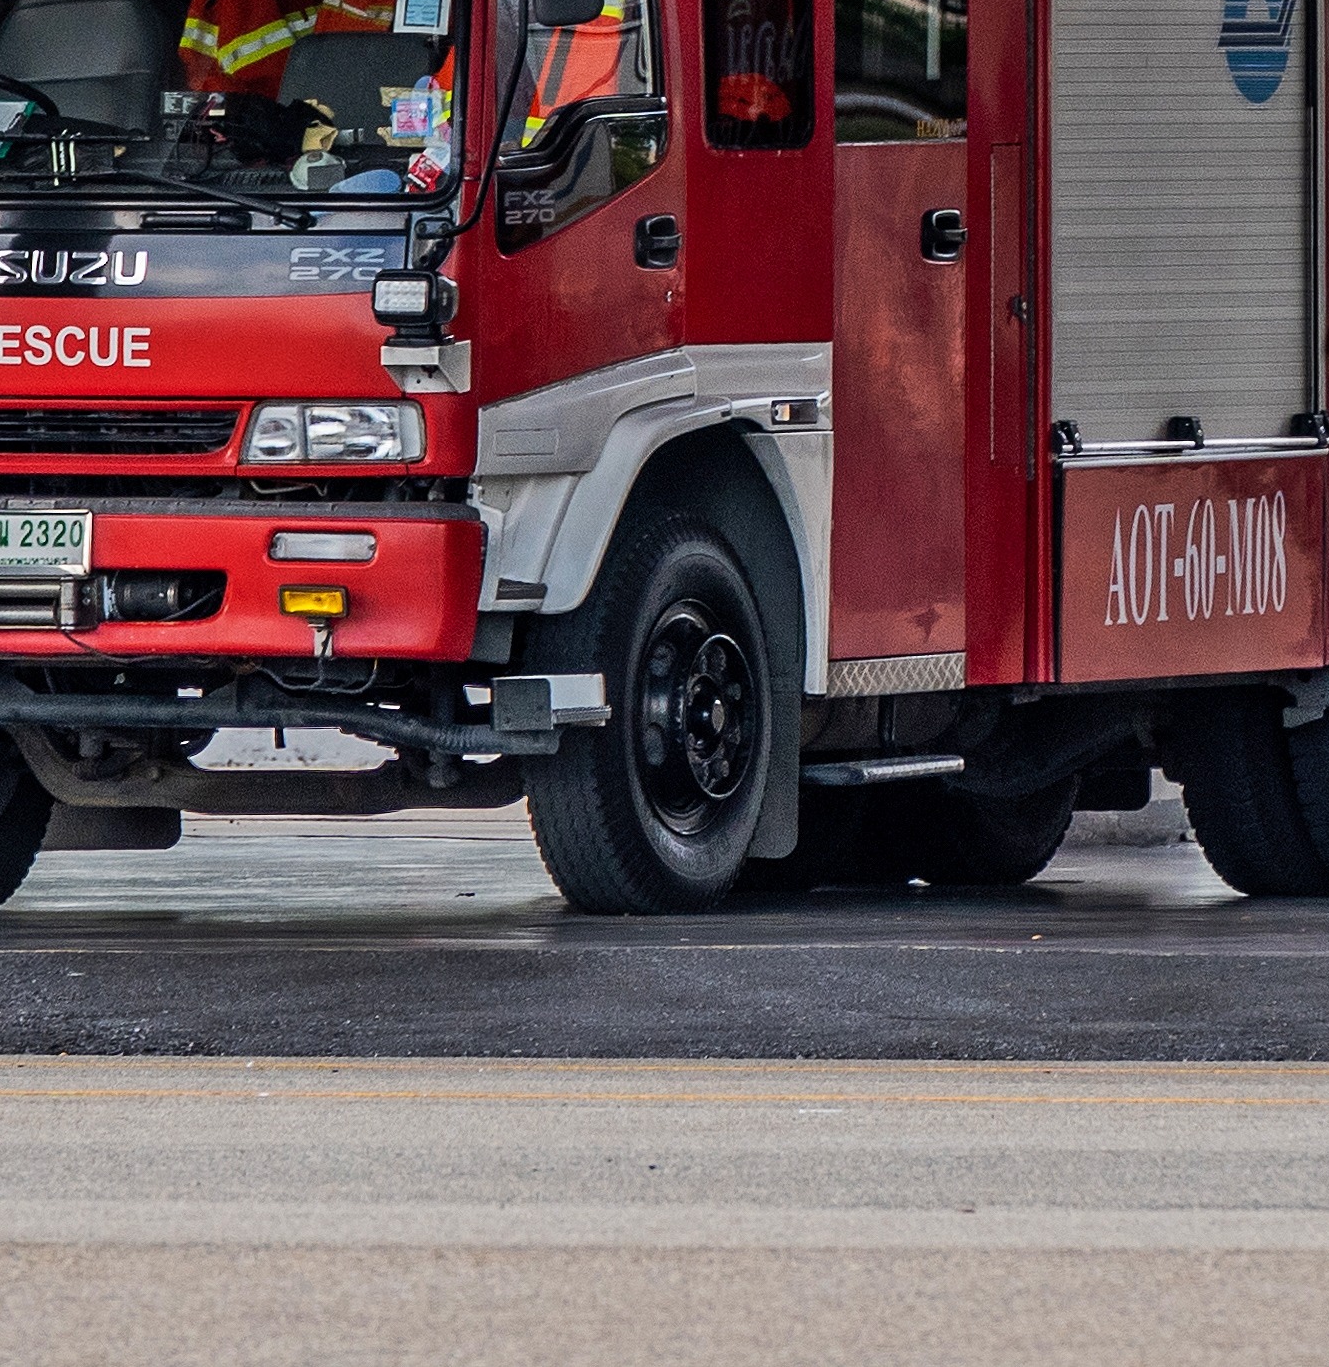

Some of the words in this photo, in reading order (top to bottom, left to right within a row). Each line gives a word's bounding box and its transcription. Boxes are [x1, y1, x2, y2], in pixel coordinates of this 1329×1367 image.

[504, 190, 555, 206] FXZ
[505, 208, 556, 224] 270
[290, 247, 385, 263] FXZ
[289, 266, 382, 281] 270
[20, 519, 83, 548] 2320
[1103, 489, 1288, 627] AOT-60-M08
